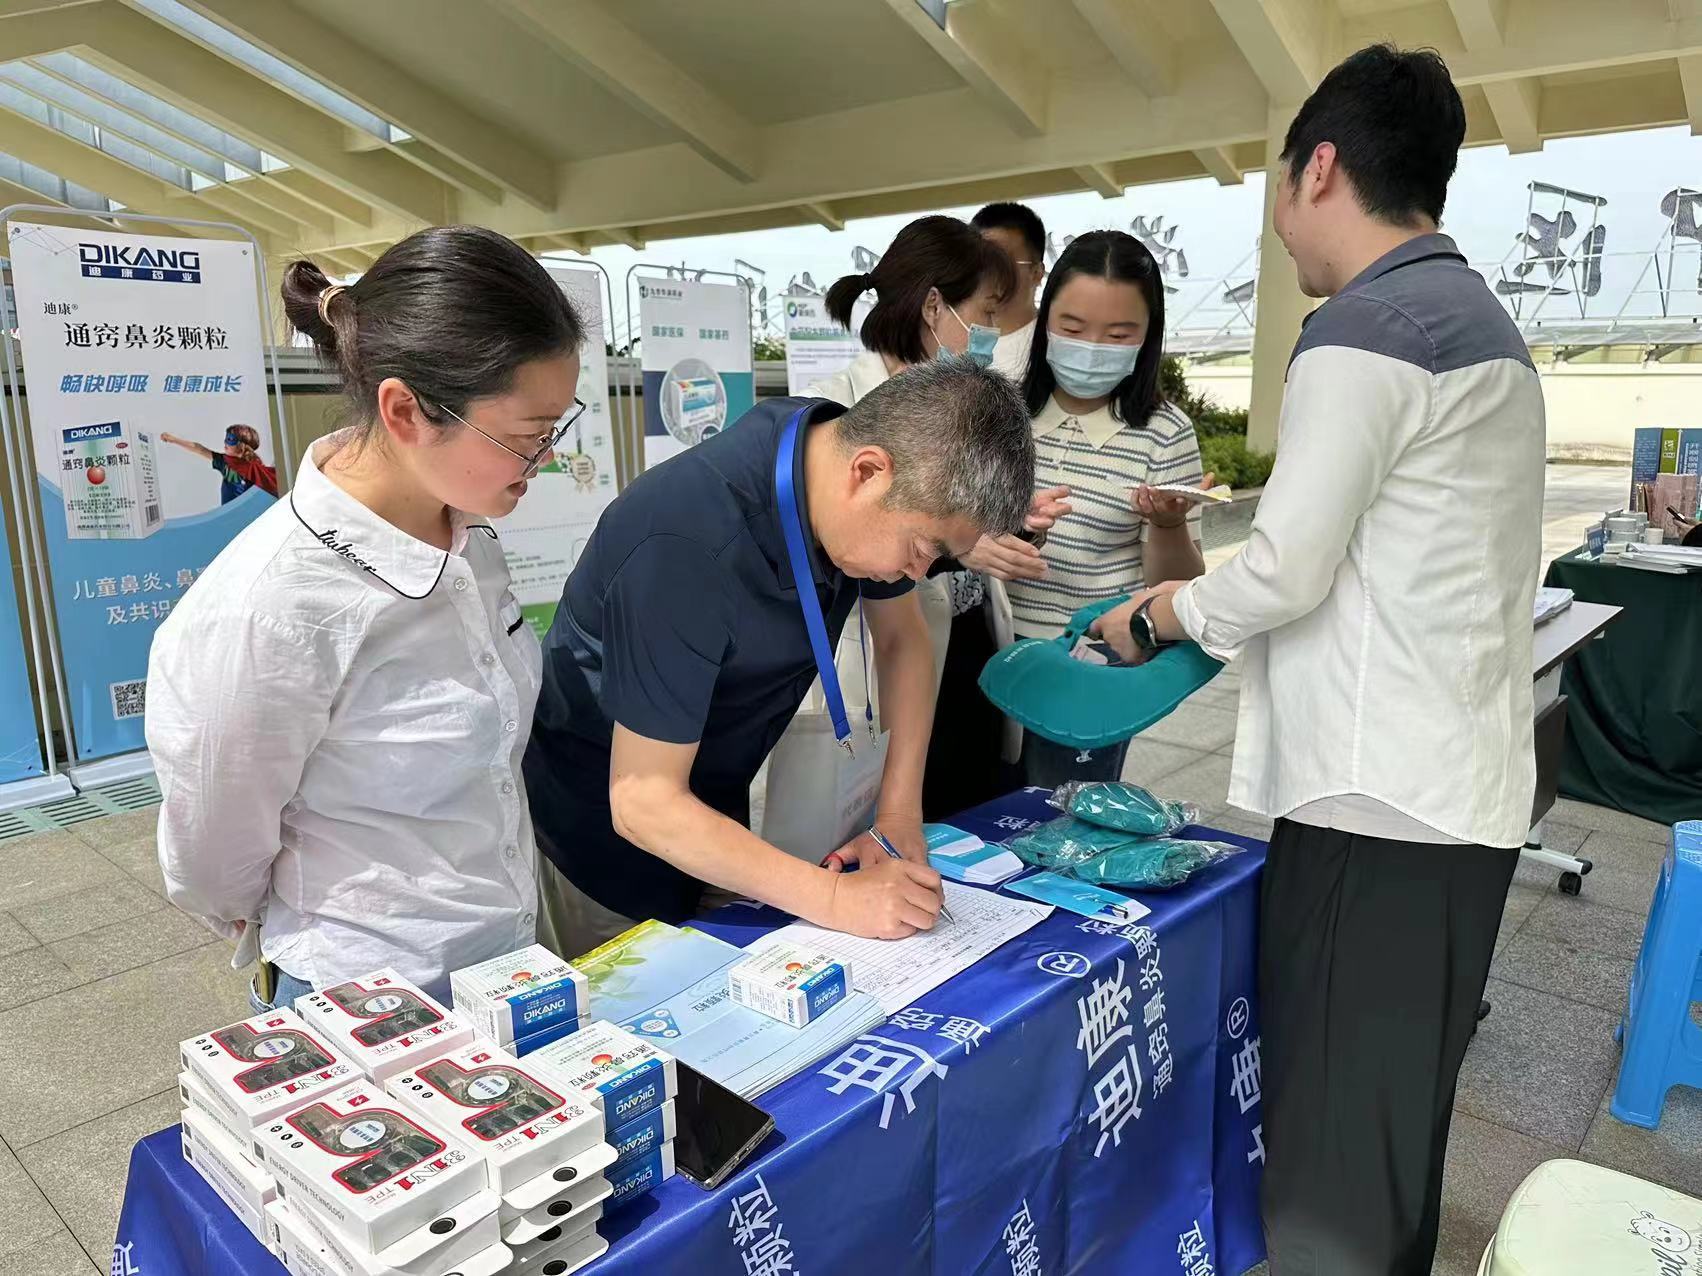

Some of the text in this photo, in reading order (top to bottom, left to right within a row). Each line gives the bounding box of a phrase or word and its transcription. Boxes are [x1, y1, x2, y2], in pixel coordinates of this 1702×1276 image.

[79, 243, 200, 270] DIKANG
[88, 266, 193, 282] 迪康药业
[63, 322, 229, 350] 通窍鼻炎颗粒
[60, 374, 243, 393] 畅快呼吸 健康成长
[71, 425, 112, 438] DIKANG
[62, 453, 130, 471] 通窍鼻炎颗粒
[73, 566, 206, 600] 儿童鼻炎、鼻
[518, 982, 562, 1001] DIKANG
[814, 985, 840, 1008] DIKANG
[523, 998, 566, 1021] DIKANG
[608, 1064, 652, 1088] DIKANG
[616, 1086, 656, 1115] DIKANG
[490, 1134, 521, 1151] TPE
[269, 1155, 344, 1224] ENERGY DRIVER TECHNOLOGY
[362, 1185, 395, 1204] TPE
[613, 1168, 653, 1198] DIKANG
